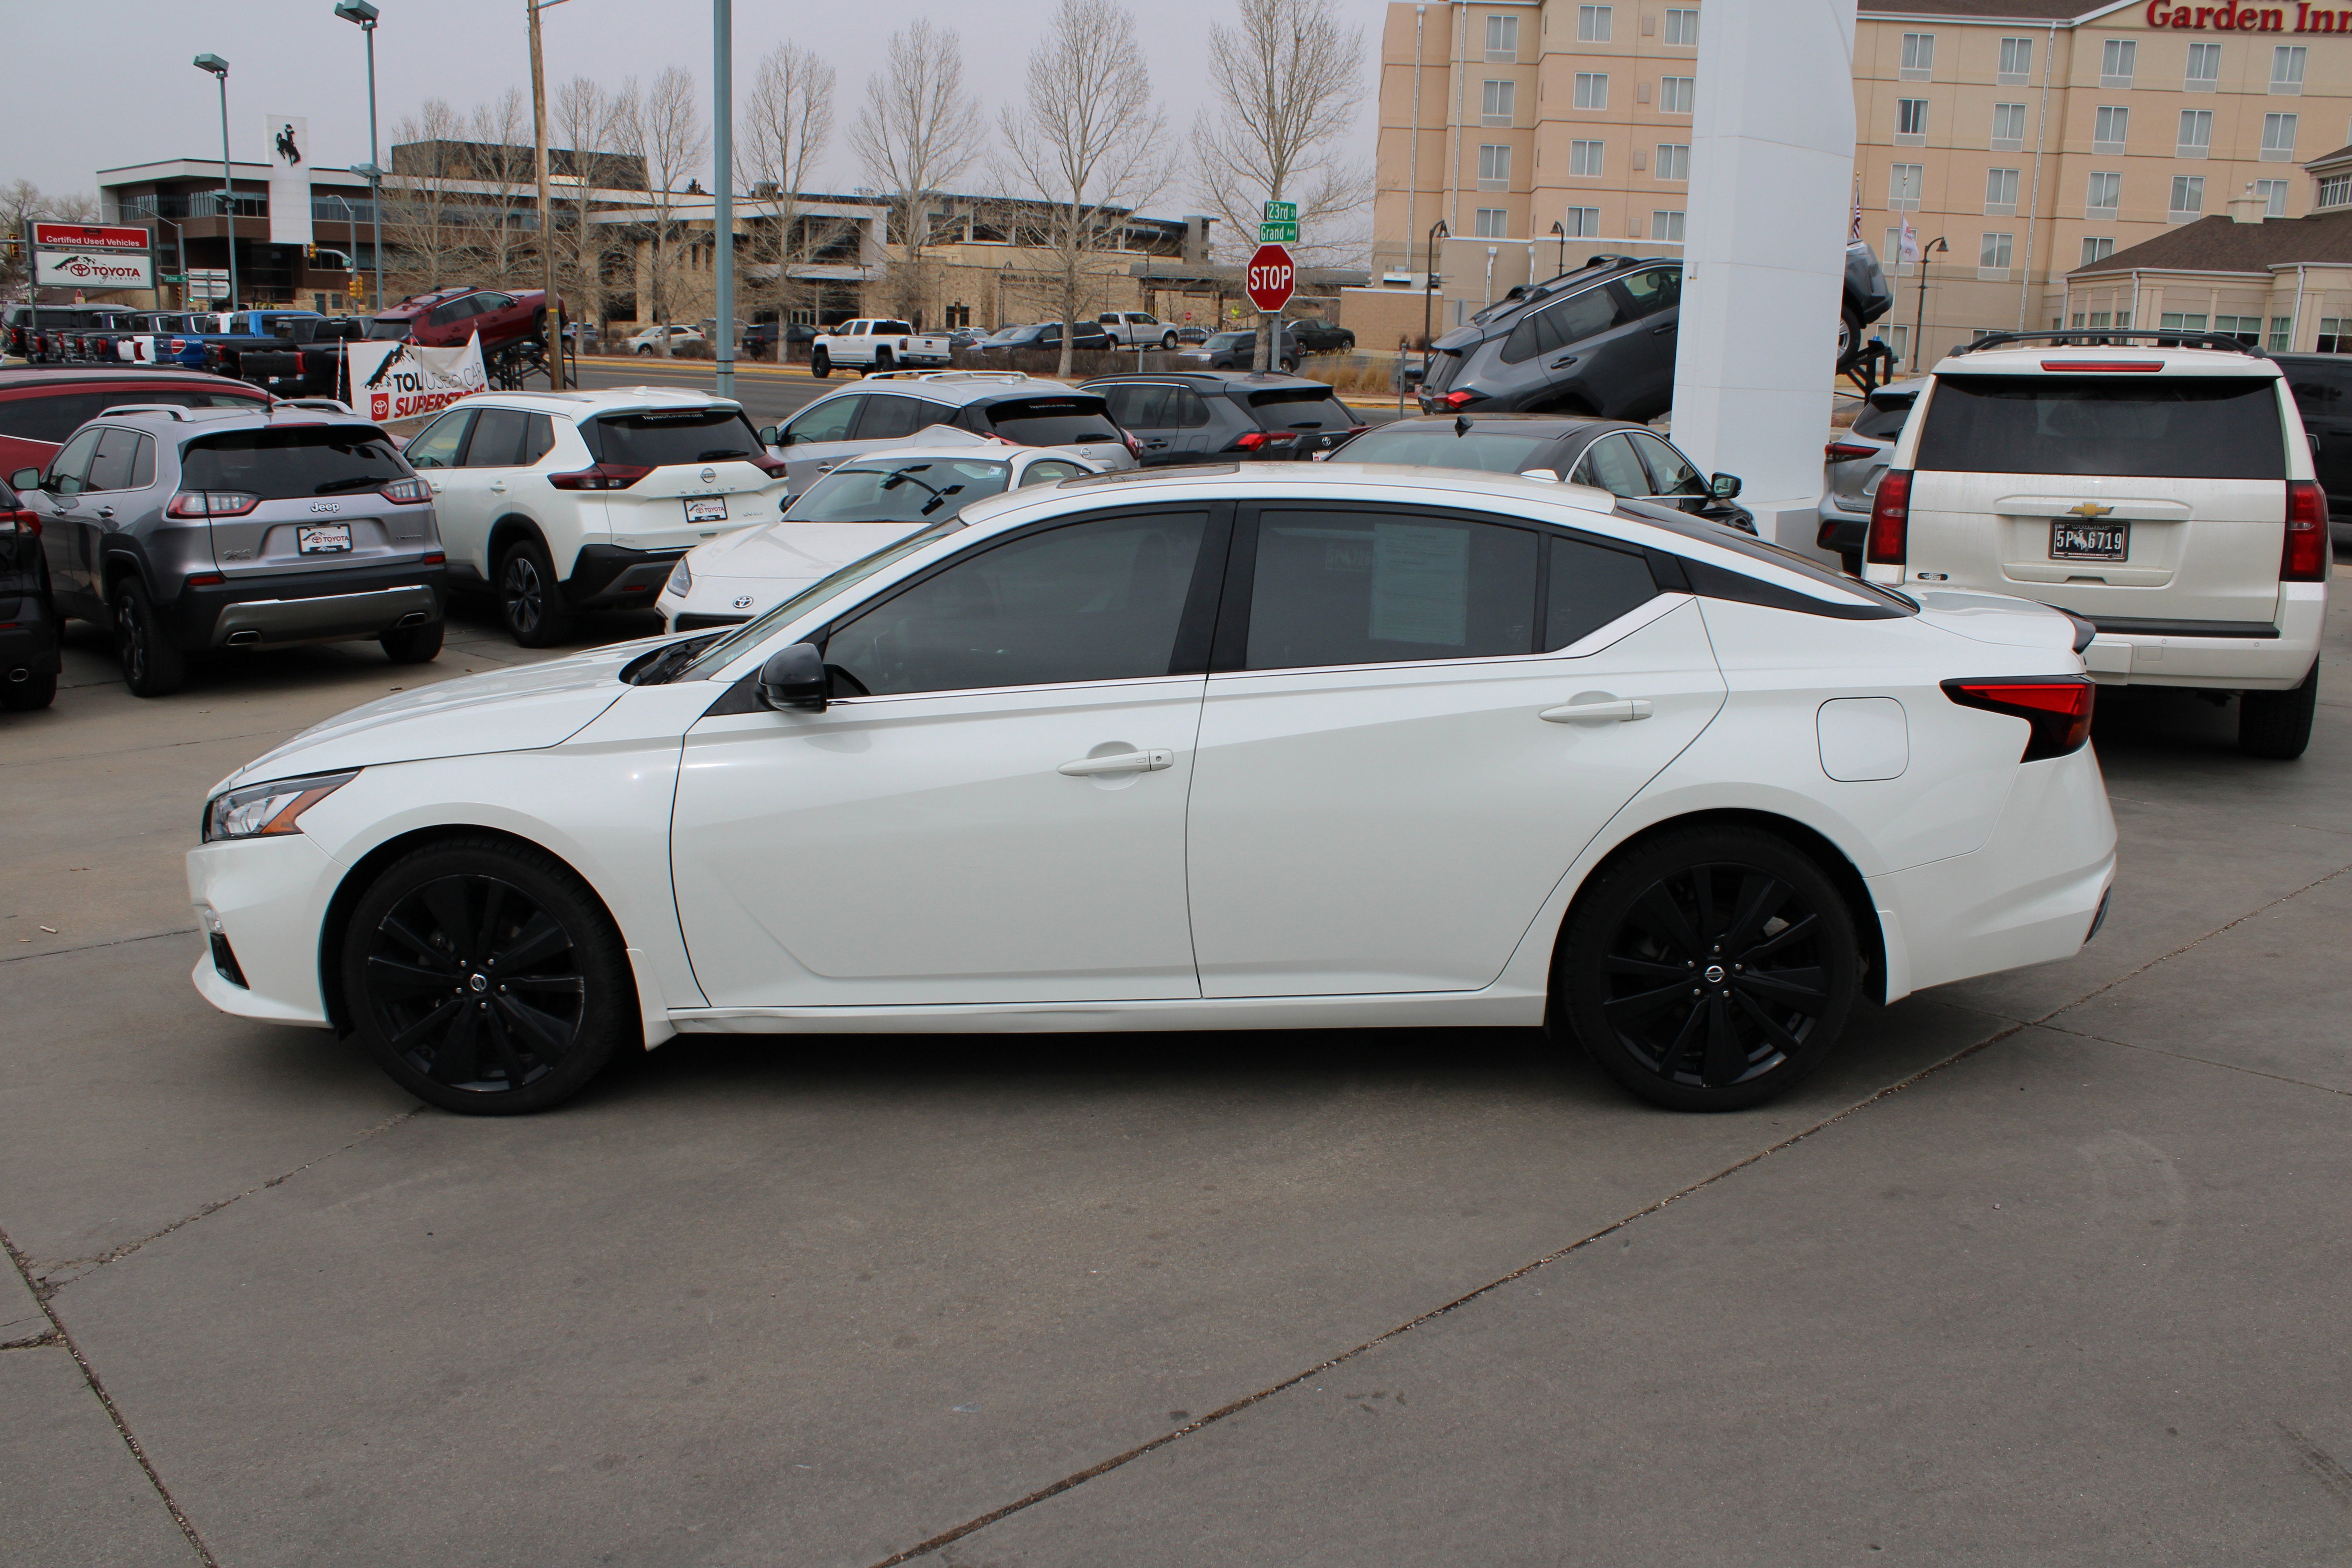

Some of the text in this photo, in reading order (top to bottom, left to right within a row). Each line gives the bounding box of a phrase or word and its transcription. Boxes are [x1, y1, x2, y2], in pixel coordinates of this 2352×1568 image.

[2147, 0, 2283, 31] Garden
[1269, 203, 1296, 220] 23rd St
[1261, 225, 1295, 241] Grand Ave
[46, 236, 81, 244] Certified
[107, 238, 140, 247] Vehicles
[91, 266, 141, 277] TOYOTA
[1250, 265, 1291, 290] STOP
[464, 362, 484, 386] CAR
[680, 486, 735, 494] ROGUE
[310, 502, 340, 513] Jeep
[2056, 530, 2122, 550] 5P 6719
